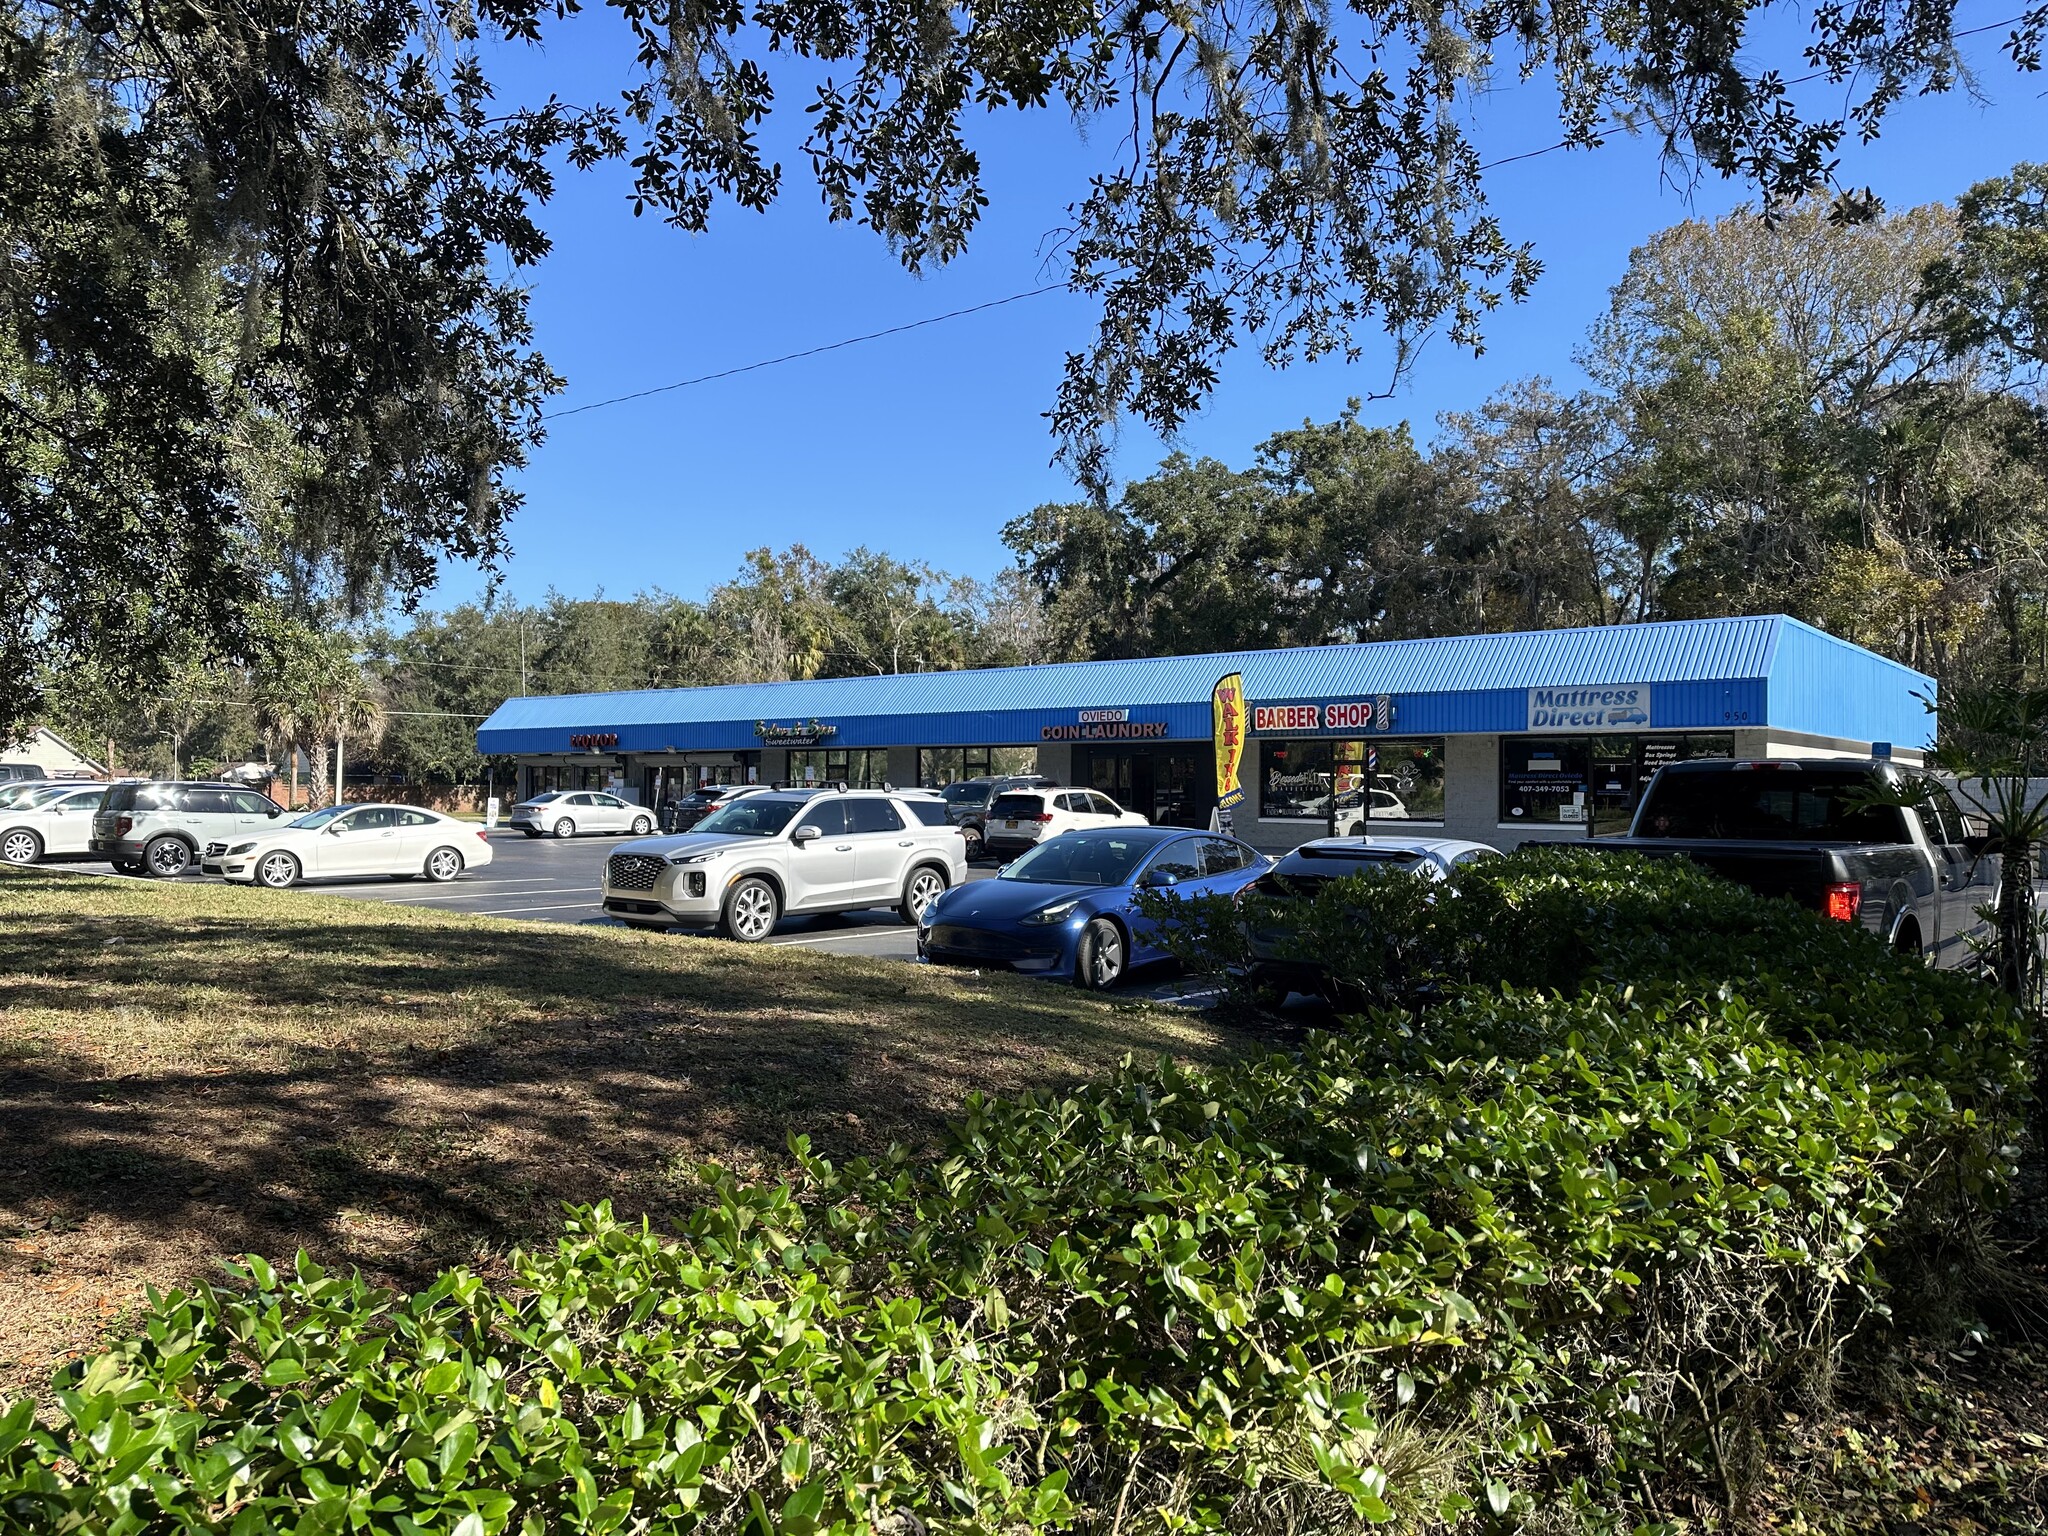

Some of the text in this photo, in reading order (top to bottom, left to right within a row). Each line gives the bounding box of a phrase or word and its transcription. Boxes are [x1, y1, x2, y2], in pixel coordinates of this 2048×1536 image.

[1533, 689, 1639, 708] Mattress
[1081, 710, 1122, 721] OVIEDO
[1217, 687, 1239, 746] WALK
[1256, 704, 1371, 729] BARBER SHOP
[1532, 707, 1607, 727] Direct
[1724, 711, 1748, 721] 950
[1041, 722, 1167, 739] COIN LAUNDRY
[570, 733, 618, 747] LIQUOR
[765, 737, 815, 746] Sweetwater
[1519, 785, 1570, 793] 407-349-7053
